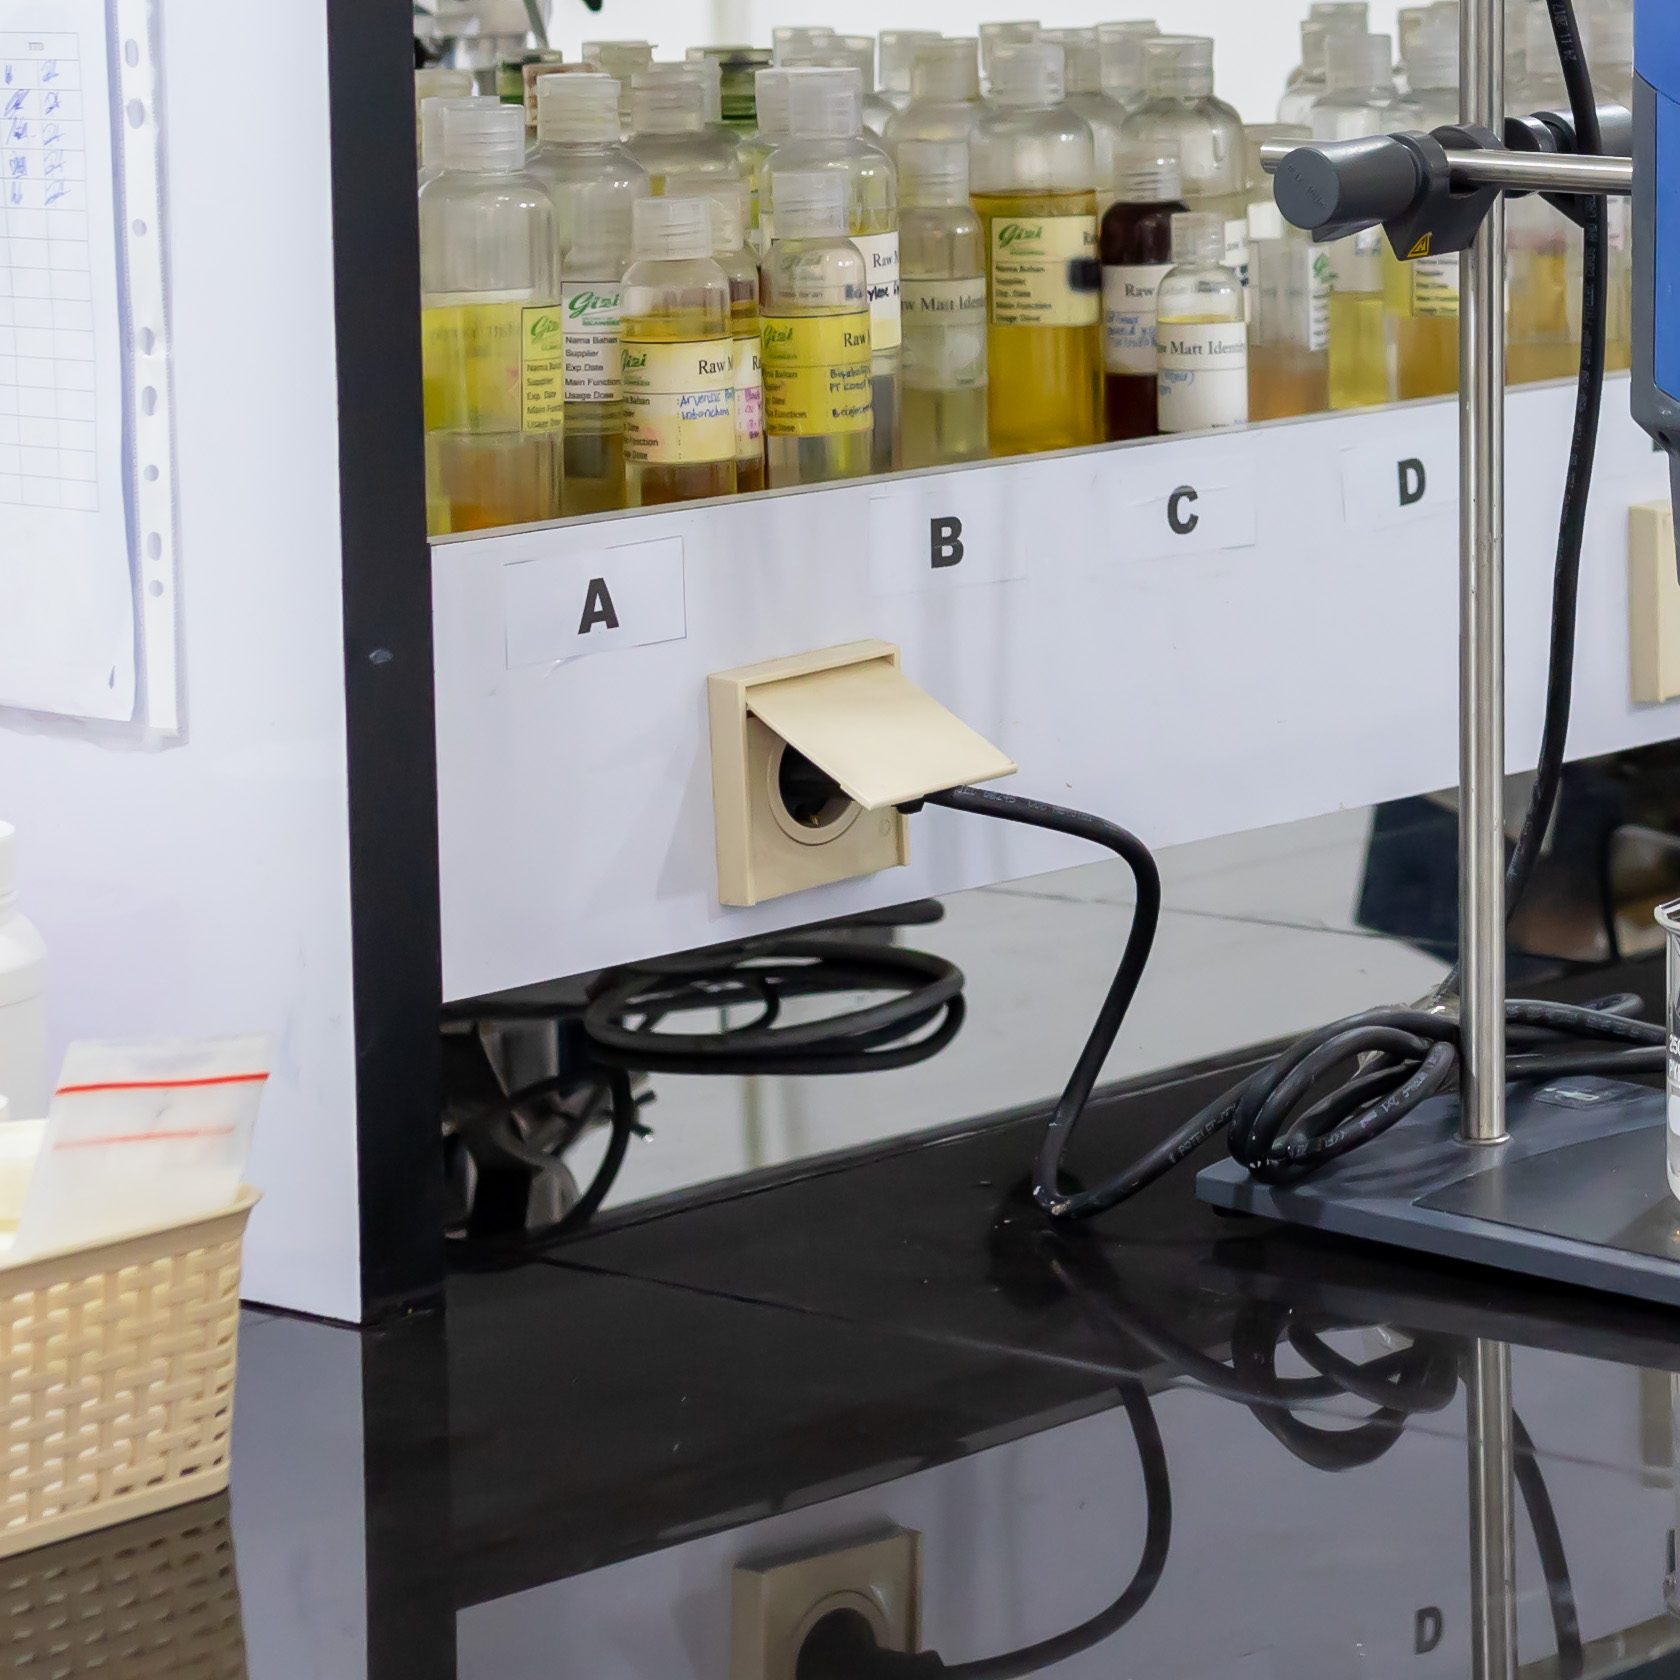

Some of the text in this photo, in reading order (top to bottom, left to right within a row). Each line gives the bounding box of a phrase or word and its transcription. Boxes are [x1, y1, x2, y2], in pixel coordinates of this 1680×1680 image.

[1124, 283, 1154, 297] Raw
[569, 290, 620, 318] Gizi
[565, 335, 620, 345] Nama Bahan
[843, 331, 868, 348] Raw
[1169, 340, 1204, 355] Matt
[565, 348, 599, 358] Supplier
[698, 359, 726, 375] Raw
[565, 377, 585, 387] Main
[565, 391, 614, 400] Usage Dose
[1396, 456, 1428, 508] D
[1165, 484, 1200, 536] C
[929, 515, 966, 570] B
[576, 576, 621, 636] A
